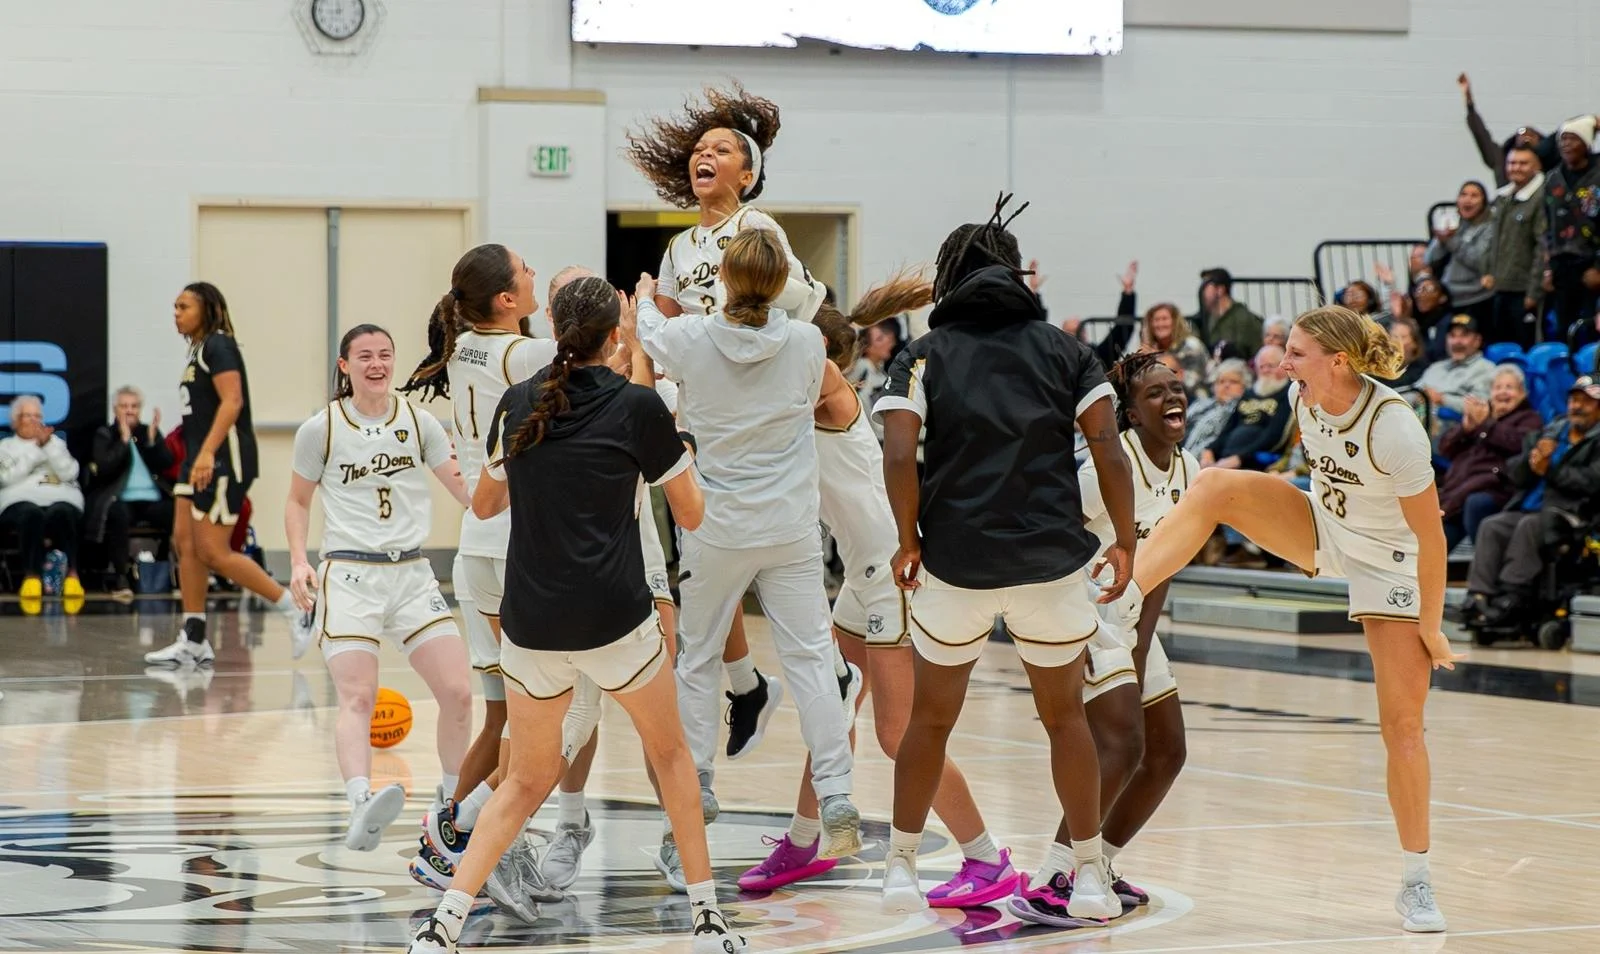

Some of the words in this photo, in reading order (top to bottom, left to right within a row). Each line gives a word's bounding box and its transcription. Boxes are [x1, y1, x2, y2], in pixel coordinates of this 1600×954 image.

[538, 146, 569, 171] EXIT
[458, 356, 470, 364] FORT
[470, 358, 487, 367] WAYNE
[461, 347, 488, 361] PURDUE
[468, 384, 479, 439] 1
[340, 463, 369, 485] The
[371, 453, 416, 475] Dons
[1320, 456, 1364, 484] Dons
[377, 487, 392, 520] 5
[1320, 481, 1347, 519] 23
[1134, 521, 1151, 540] he
[370, 727, 404, 741] Wilso
